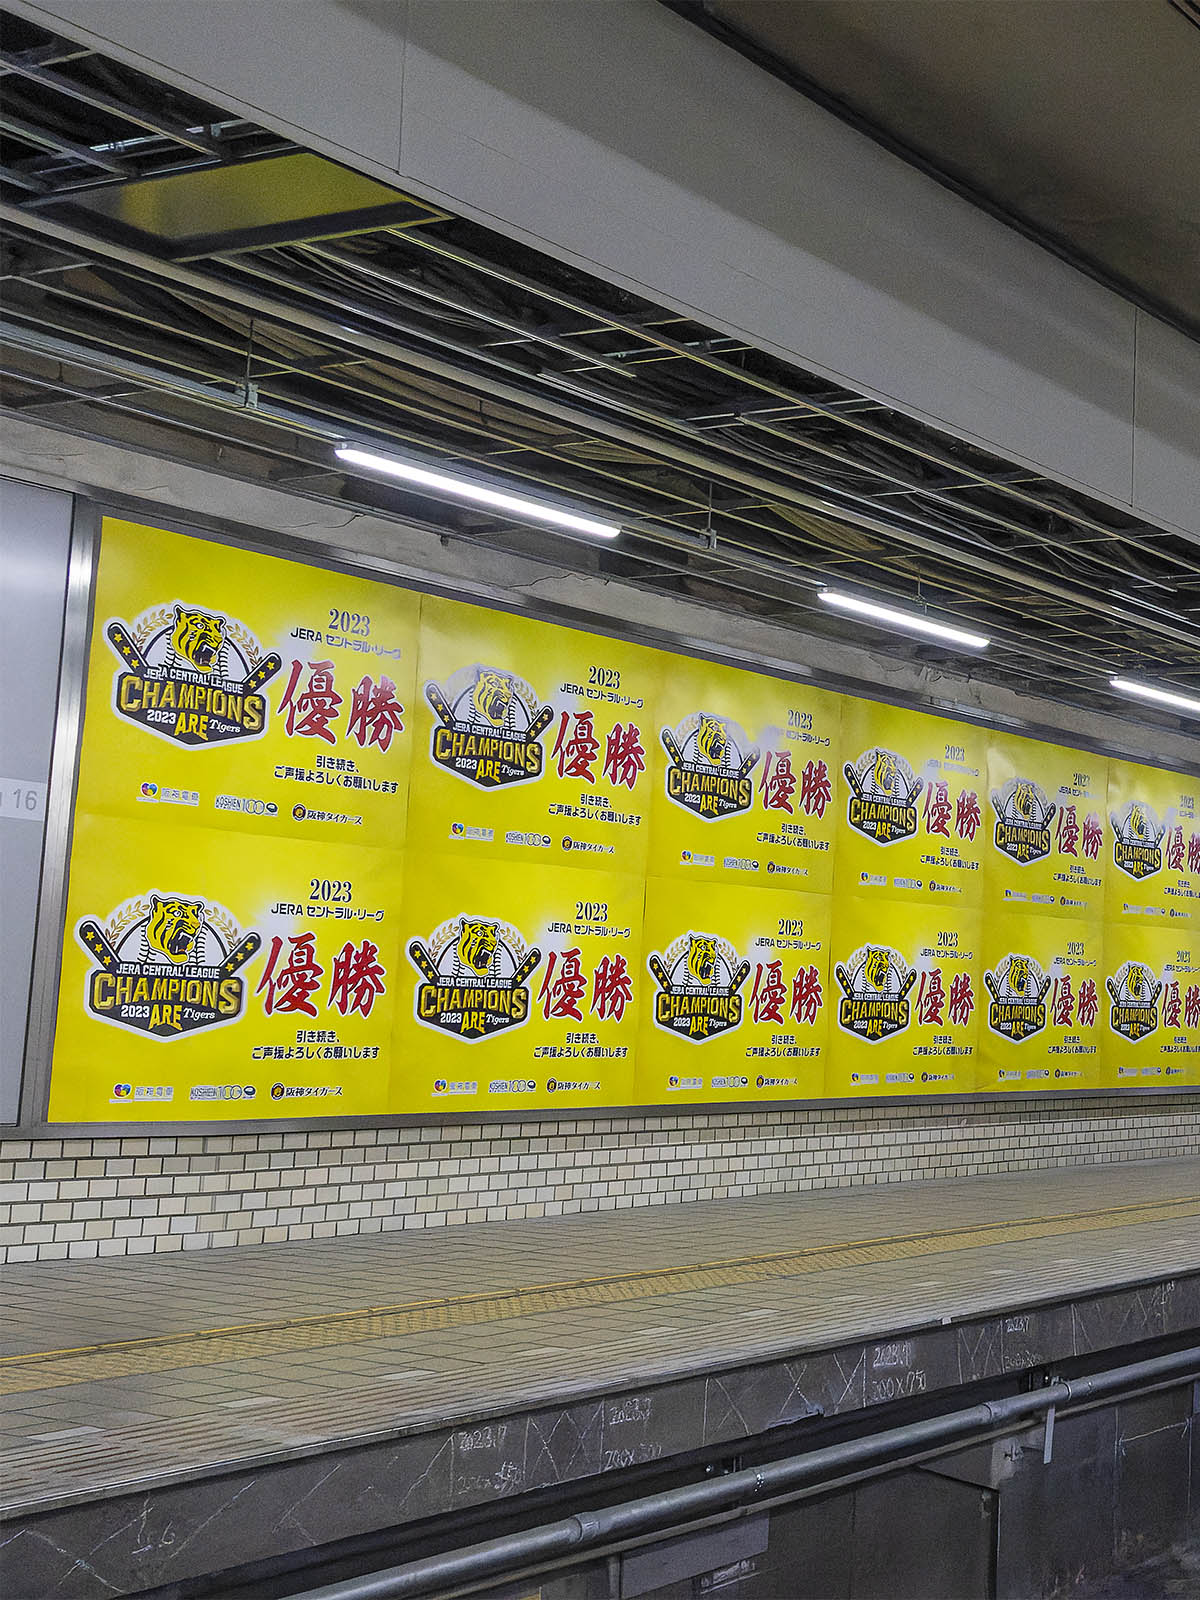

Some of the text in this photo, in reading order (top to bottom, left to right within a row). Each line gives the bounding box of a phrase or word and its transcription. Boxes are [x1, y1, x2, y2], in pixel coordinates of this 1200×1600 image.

[328, 608, 369, 636] 2023
[291, 627, 400, 659] JERA セントラル・リーグ
[143, 666, 243, 694] JERA CENTRAL LEAGUE
[588, 665, 619, 689] 2023
[121, 673, 262, 732] CHAMPIONS
[278, 659, 402, 750] 優勝
[561, 683, 643, 708] JERA セントラル・リーグ
[148, 708, 239, 740] 2023 ARE Tigers
[452, 721, 525, 742] JERA CENTRAL LEAGUE
[787, 709, 811, 730] 2023
[437, 727, 540, 774] CHAMPIONS
[551, 711, 644, 788] 優勝
[944, 745, 964, 762] 2023
[317, 755, 359, 772] 引き続き、
[456, 757, 523, 783] 2023 ARE Tigers
[274, 766, 397, 792] ご声援よろしくお願いします
[669, 767, 749, 807] CHAMPIONS
[758, 750, 831, 817] 優勝
[13, 788, 38, 812] 16
[580, 794, 612, 808] 引き続き、
[684, 792, 736, 815] 2023 ARE Tigers
[922, 780, 980, 840] 優勝
[306, 808, 362, 825] 阪神タイガース
[549, 804, 640, 824] ご声援よろしくお願いします
[851, 798, 915, 832] CHAMPIONS
[875, 821, 890, 840] ARE
[997, 822, 1049, 852] CHAMPIONS
[1054, 805, 1102, 859] 優勝
[1115, 842, 1160, 868] CHAMPIONS
[310, 879, 352, 902] 2023
[271, 903, 384, 922] JERA セントラル・リーグ
[576, 901, 607, 921] 2023
[548, 922, 631, 937] JERA セントラル・リーグ
[778, 919, 803, 936] 2023
[938, 932, 957, 947] 2023
[756, 938, 821, 950] JERA セントラル・リーグ
[920, 949, 935, 957] JERA
[116, 963, 220, 978] JERA CENTRAL LEAGUE
[256, 932, 385, 1017] 優勝
[437, 976, 511, 988] JERA CENTRAL LEAGUE
[94, 973, 240, 1014] CHAMPIONS
[538, 948, 632, 1020] 優勝
[749, 960, 823, 1024] 優勝
[421, 985, 526, 1019] CHAMPIONS
[658, 993, 740, 1022] CHAMPIONS
[915, 968, 974, 1025] 優勝
[1050, 975, 1098, 1027] 優勝
[121, 1004, 216, 1030] 2023 ARE Tigers
[440, 1011, 508, 1033] 2023 ARE Tigers
[842, 999, 907, 1025] CHAMPIONS
[991, 1003, 1044, 1026] CHAMPIONS
[1112, 1006, 1156, 1027] CHAMPIONS
[296, 1031, 340, 1043] 引き続き、
[673, 1017, 689, 1026] 2023
[688, 1016, 708, 1035] ARE
[866, 1019, 882, 1036] ARE
[567, 1033, 599, 1043] 引き続き、
[252, 1047, 379, 1059] ご声援よろしくお願いします
[535, 1046, 627, 1057] ご声援よろしくお願いします
[285, 1086, 343, 1098] 阪神タイガース
